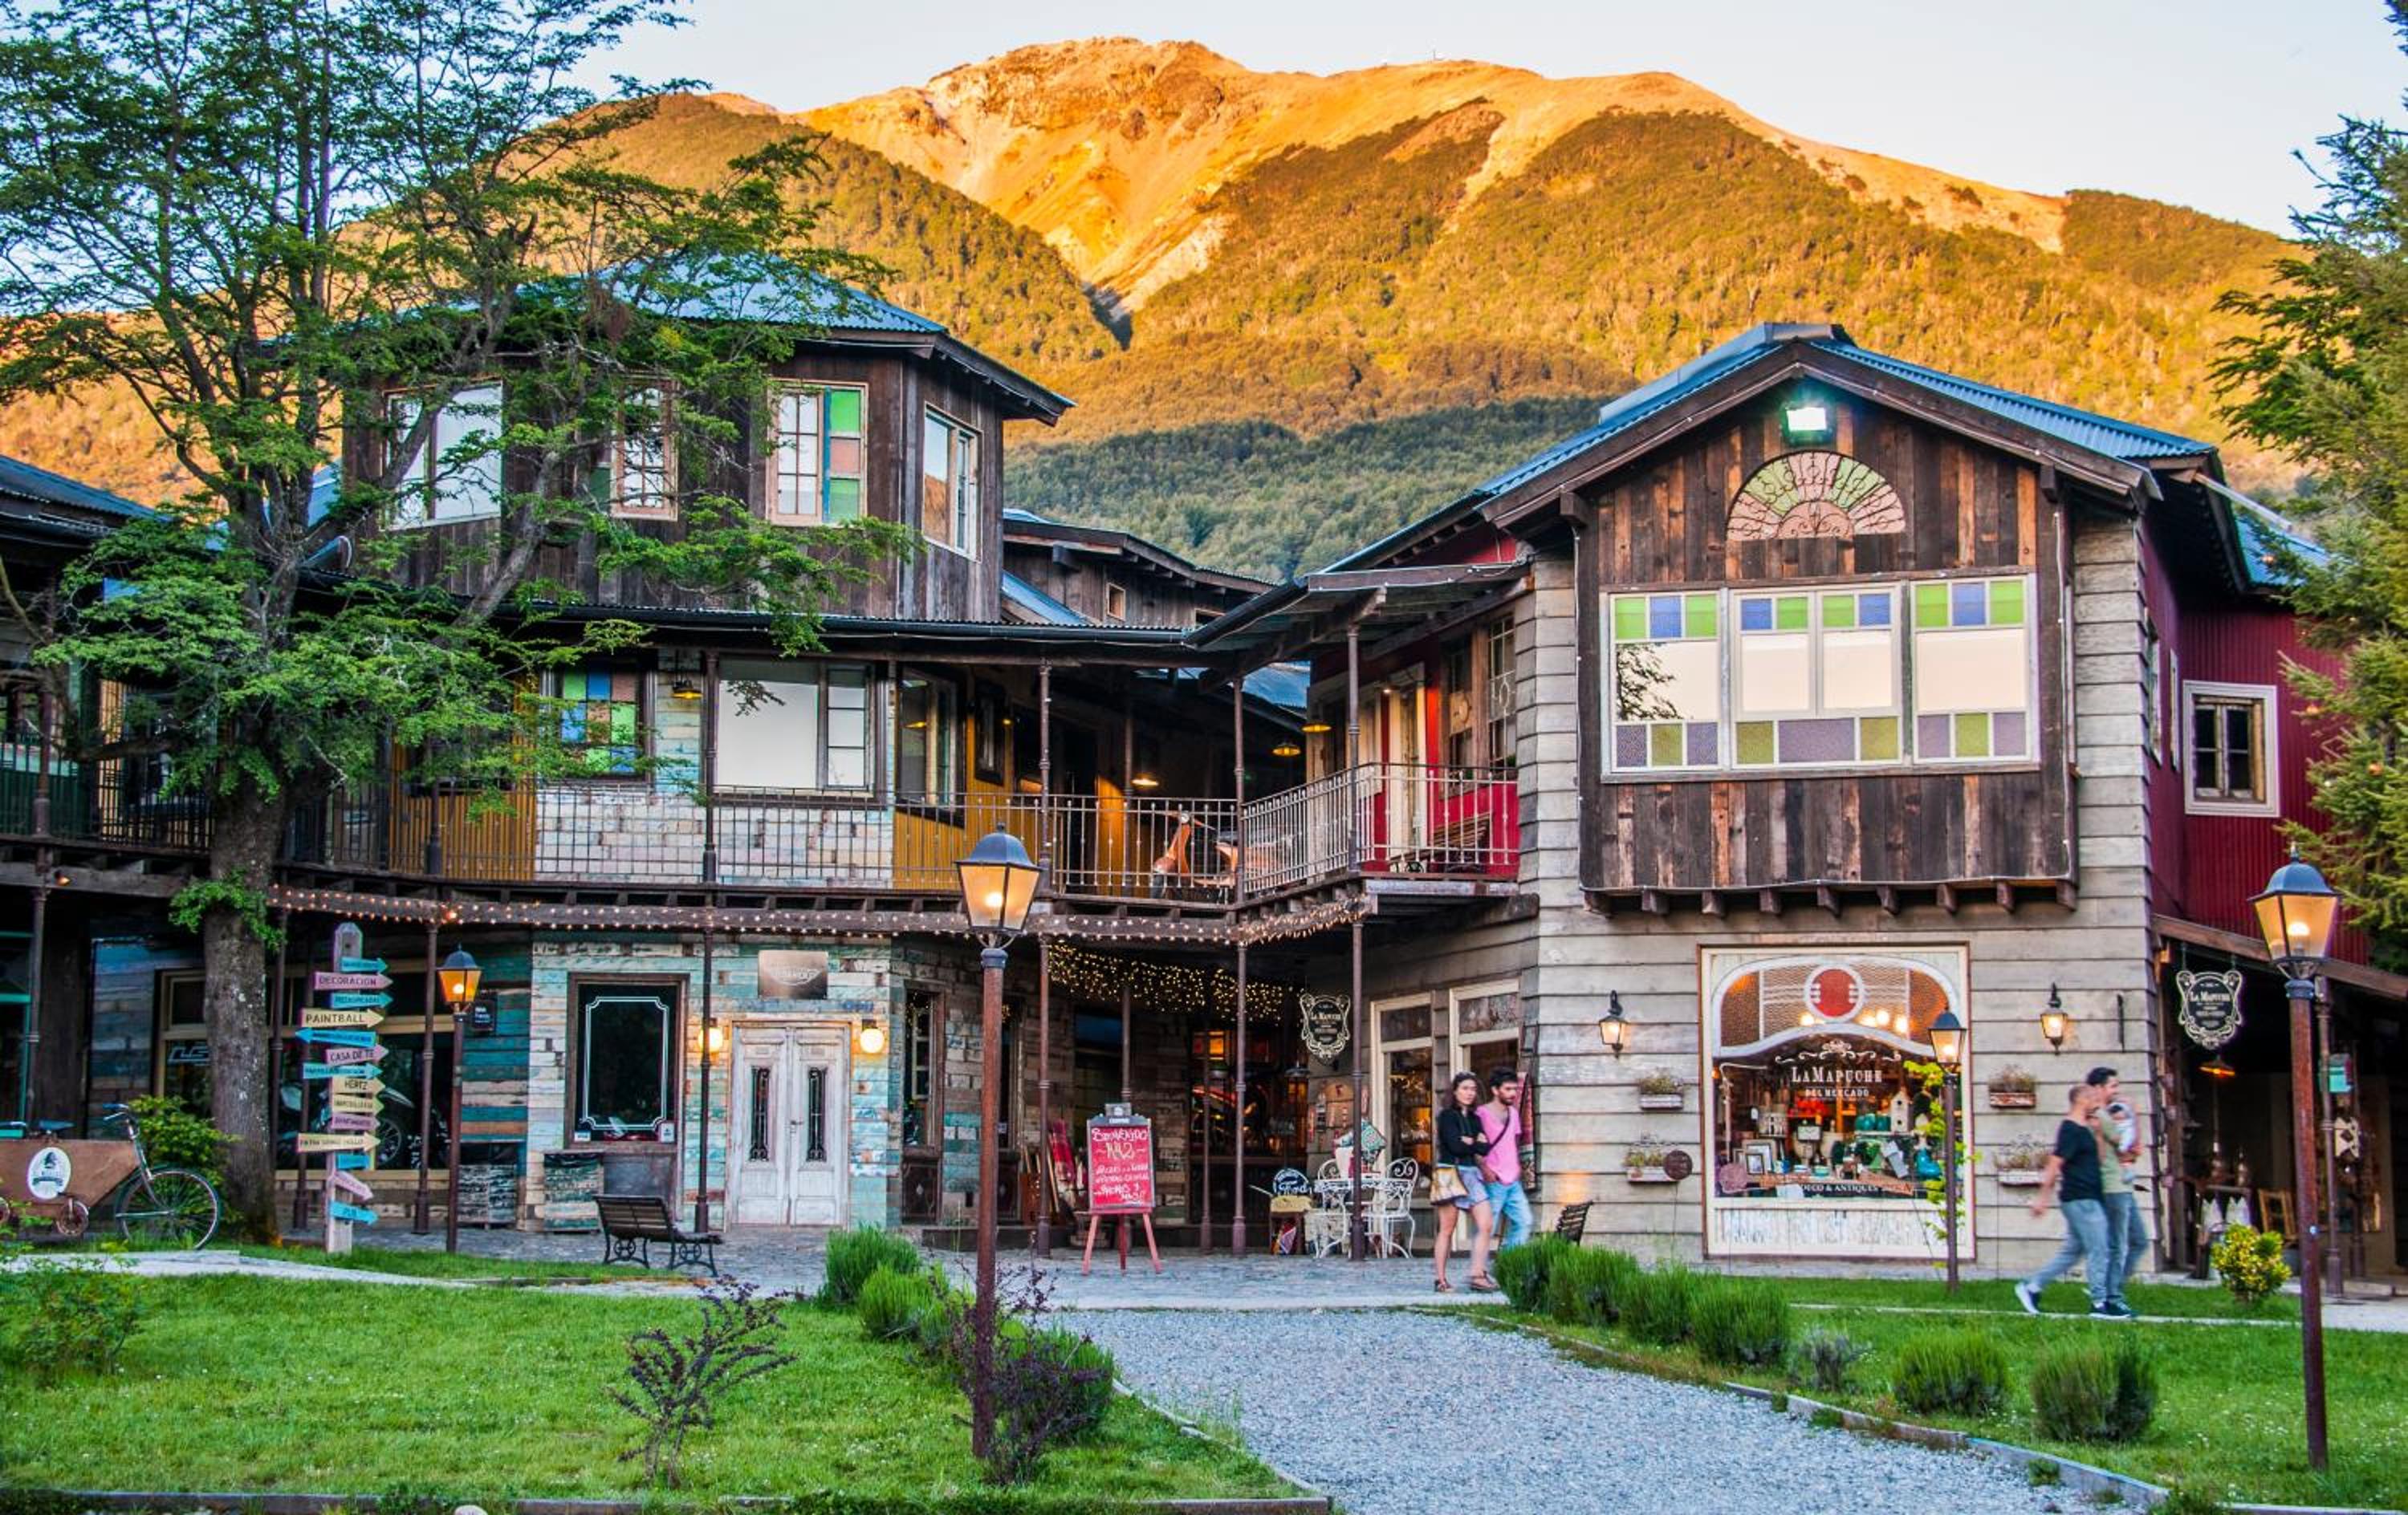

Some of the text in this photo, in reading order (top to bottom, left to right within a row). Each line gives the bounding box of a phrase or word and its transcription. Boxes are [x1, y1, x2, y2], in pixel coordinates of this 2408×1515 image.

[307, 1013, 364, 1024] PAINTBALL
[330, 1051, 351, 1062] CASA
[352, 1050, 363, 1060] DE
[345, 1079, 368, 1091] HERTZ
[1805, 1088, 1869, 1097] DEL MERCADO
[1826, 1184, 1832, 1192] &
